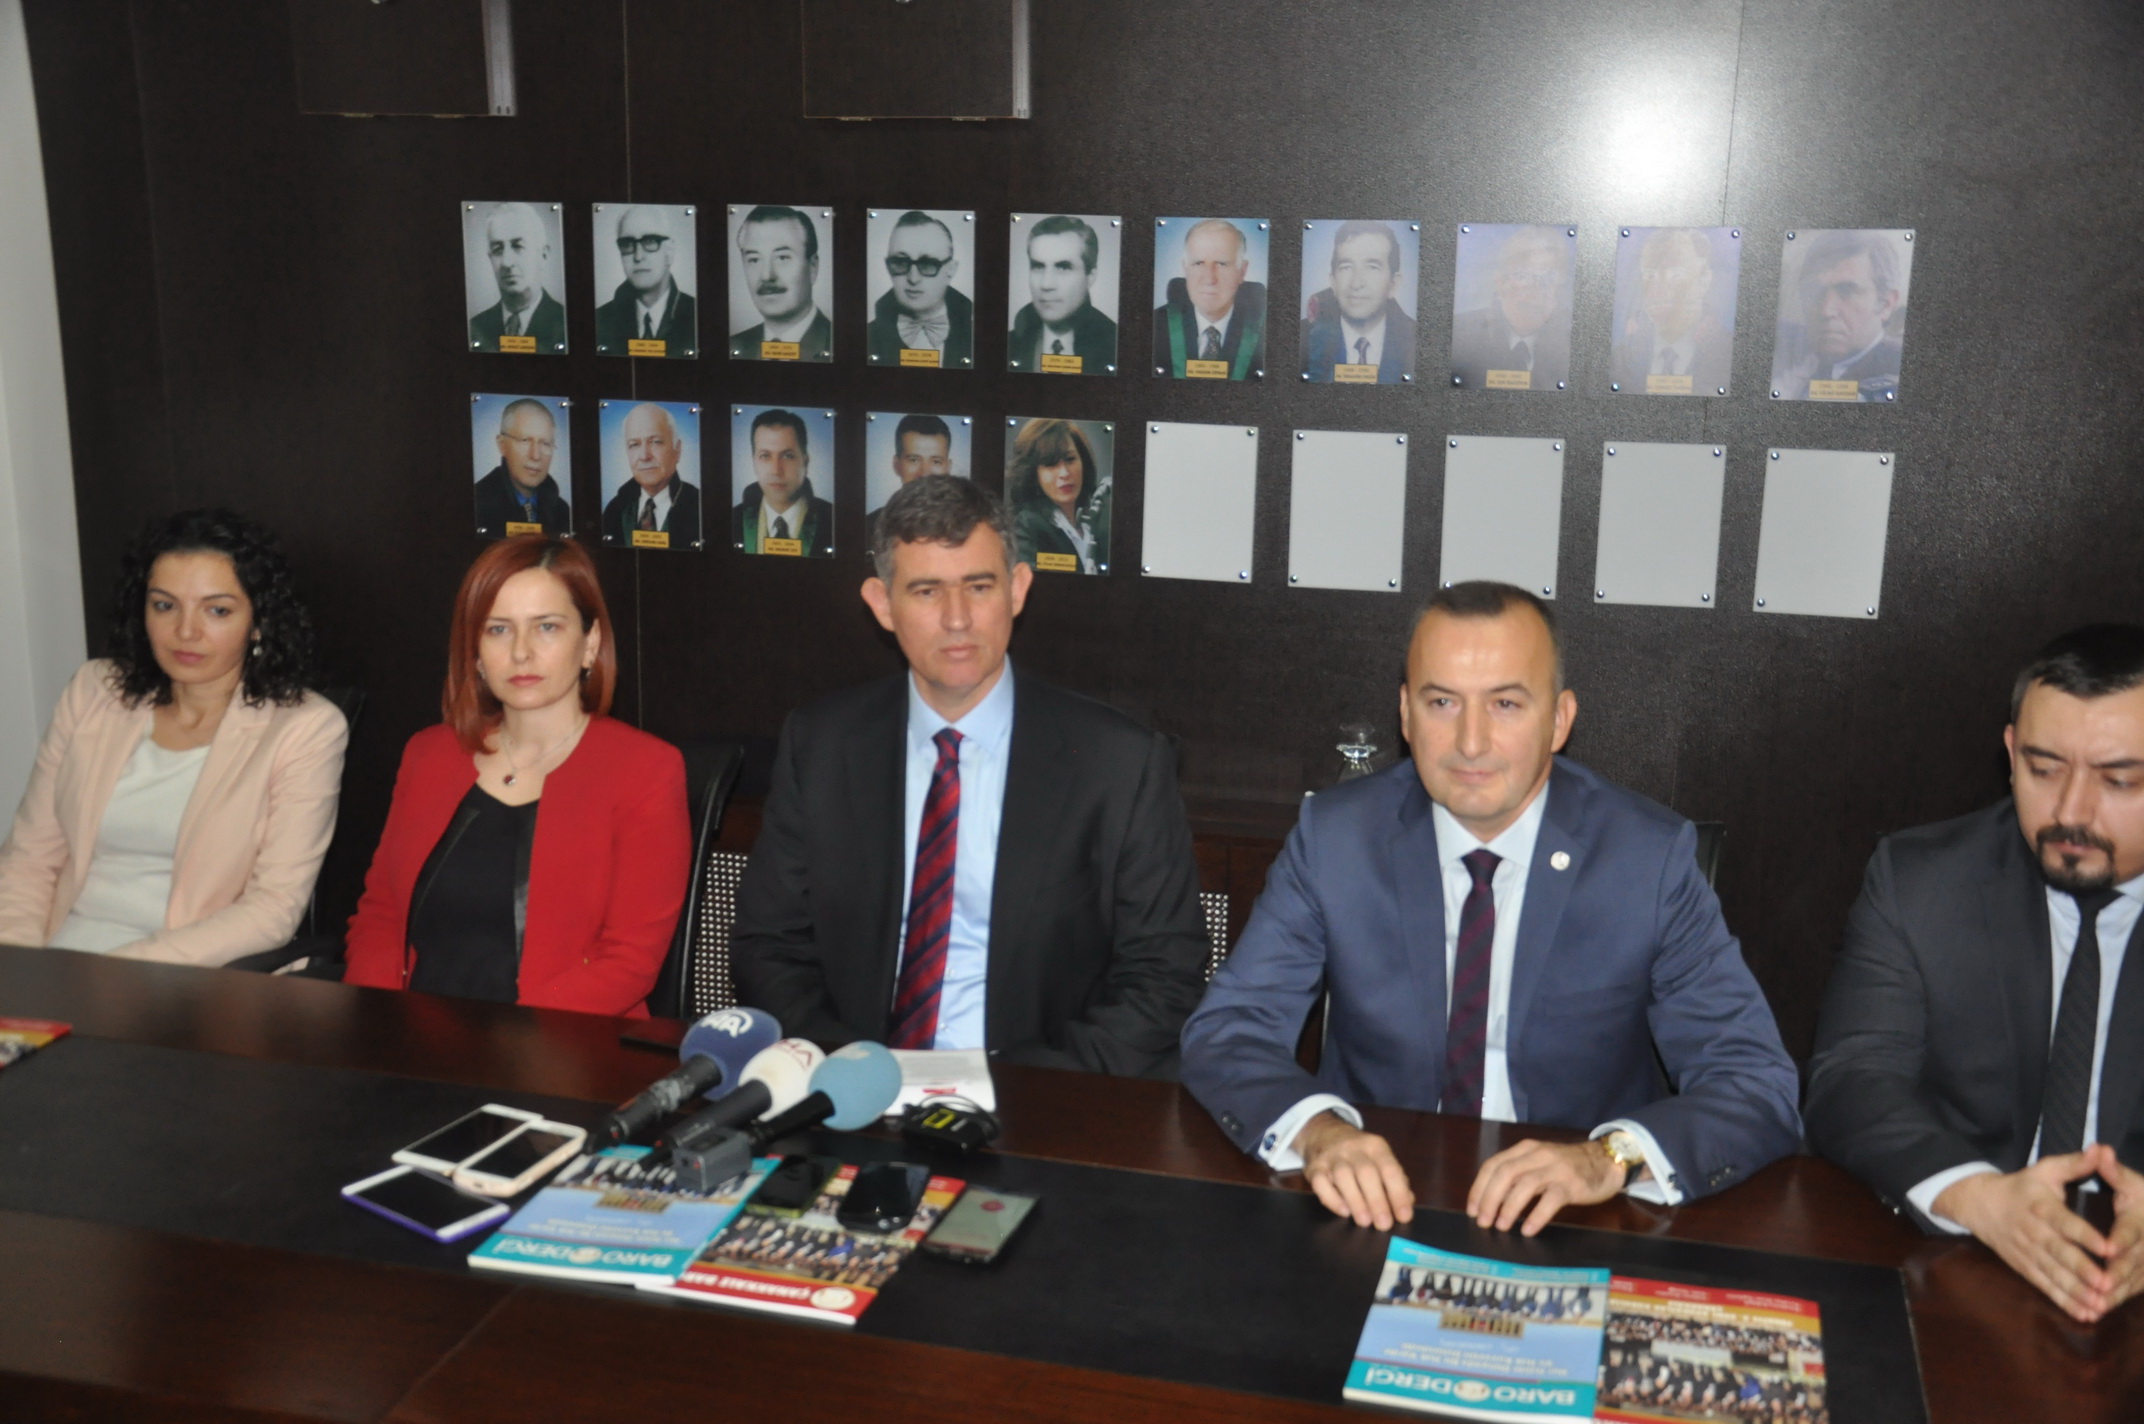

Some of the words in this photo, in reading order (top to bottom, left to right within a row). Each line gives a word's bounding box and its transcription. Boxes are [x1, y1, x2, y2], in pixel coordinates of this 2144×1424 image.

[602, 1246, 672, 1268] BARO
[1364, 1365, 1454, 1395] DERGİ
[1494, 1383, 1576, 1406] BARO
